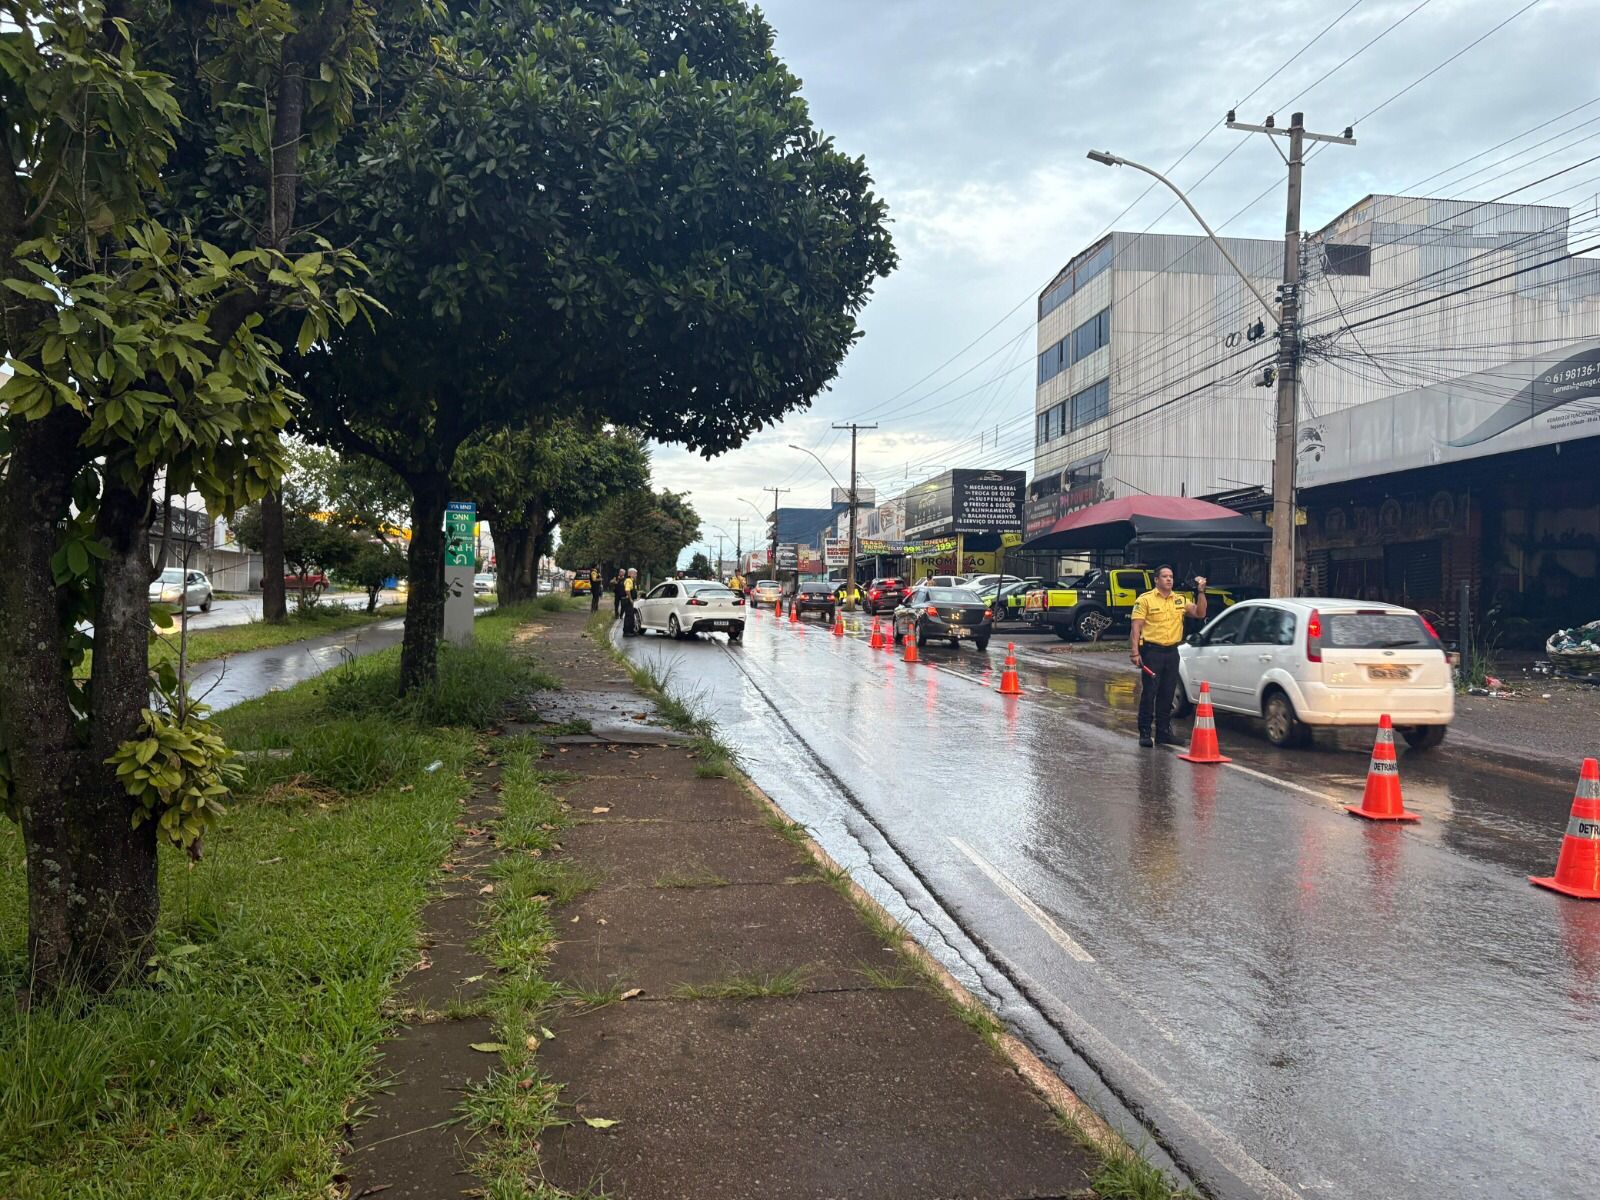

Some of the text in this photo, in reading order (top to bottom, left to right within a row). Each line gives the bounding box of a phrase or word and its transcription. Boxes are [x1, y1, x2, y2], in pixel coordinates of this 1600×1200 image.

[456, 524, 466, 532] 10
[466, 544, 473, 552] H
[922, 556, 985, 566] PROMÃO
